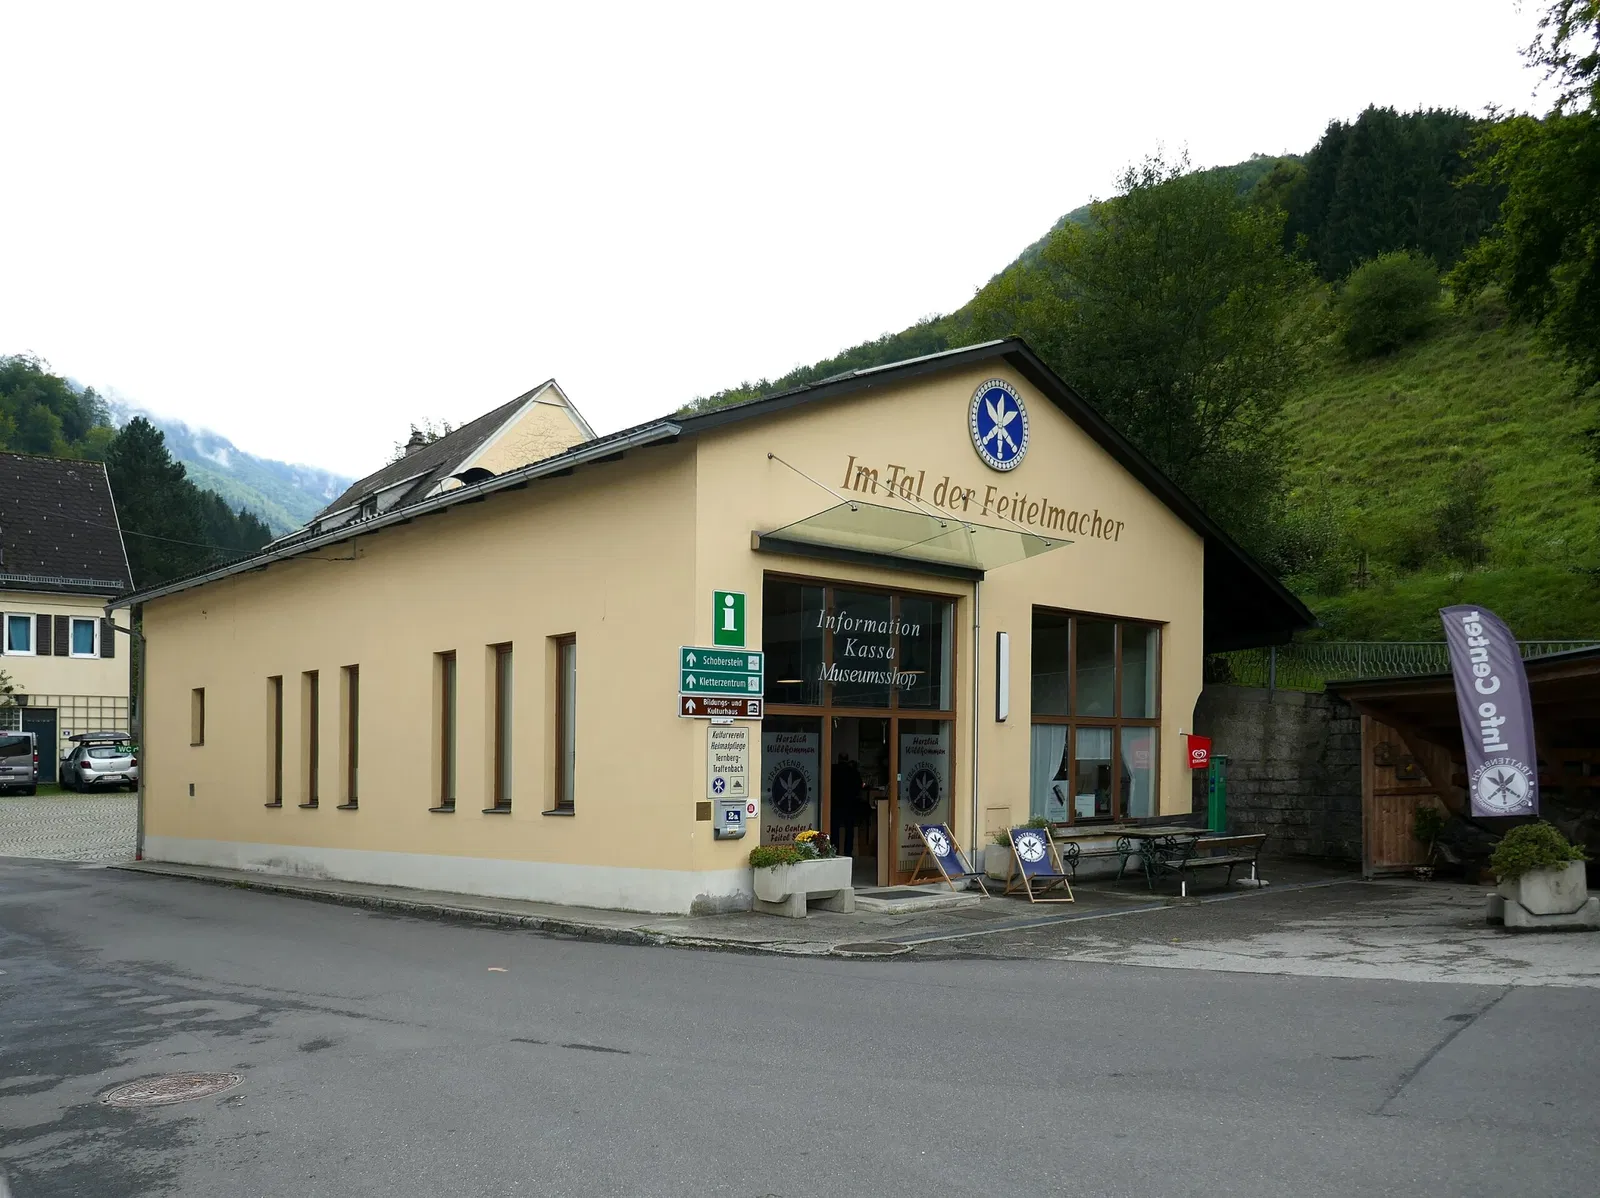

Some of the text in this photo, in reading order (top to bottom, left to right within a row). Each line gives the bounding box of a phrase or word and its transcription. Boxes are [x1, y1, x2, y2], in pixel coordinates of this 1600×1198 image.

[840, 455, 1125, 543] Im Tal der Feitelmacher
[816, 609, 921, 636] Information
[844, 638, 896, 660] Kassa
[702, 655, 744, 667] Schoberstein
[699, 676, 746, 688] Kletterzentrum
[818, 662, 917, 691] Museumsshop
[703, 698, 730, 708] Bildungs-
[707, 707, 738, 715] Kulturhaus
[712, 730, 745, 739] Kulturverein
[775, 733, 807, 744] Herzlich
[711, 741, 746, 751] Heimatpflege
[912, 736, 939, 745] Herzlich
[767, 744, 815, 755] Willkommen
[905, 745, 946, 756] Willkommen
[715, 753, 741, 763] Ternberg-
[713, 764, 744, 773] Trattenbach
[767, 758, 812, 783] TRATTENBACH
[728, 811, 739, 820] 2a
[766, 824, 784, 834] Info
